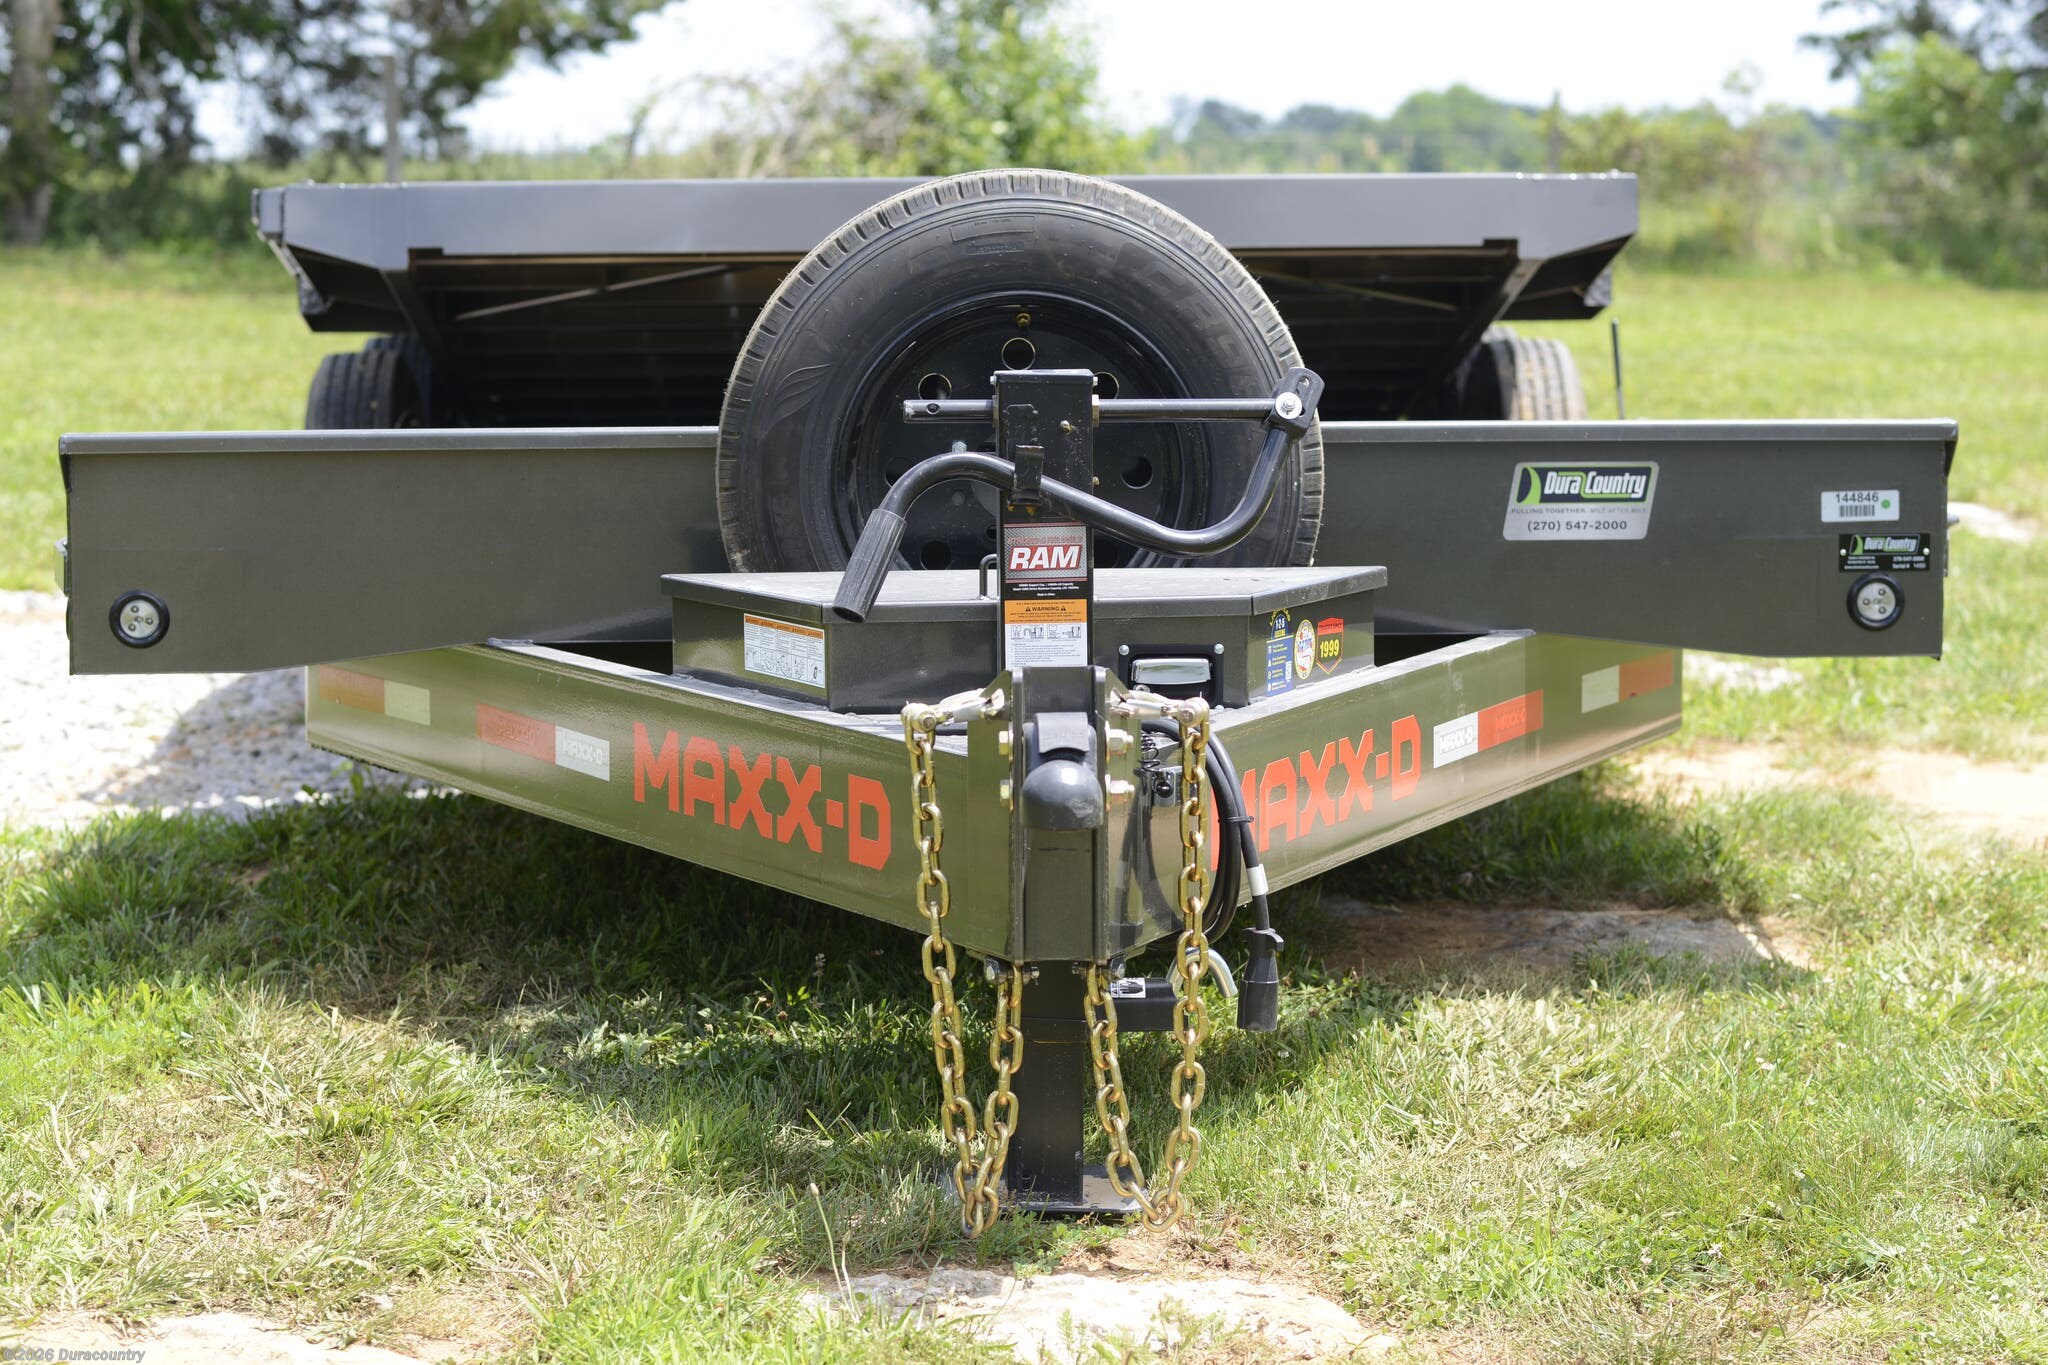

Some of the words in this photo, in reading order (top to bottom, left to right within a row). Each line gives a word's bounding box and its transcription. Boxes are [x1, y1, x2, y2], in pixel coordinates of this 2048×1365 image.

[1543, 471, 1582, 495] Dura
[1584, 470, 1647, 499] Country
[1835, 492, 1879, 503] 144846
[1527, 520, 1561, 532] (270)
[1565, 520, 1628, 531] 547-2000
[1010, 545, 1080, 571] RAM
[1320, 639, 1339, 658] 1999
[633, 721, 892, 871] MAXX-D
